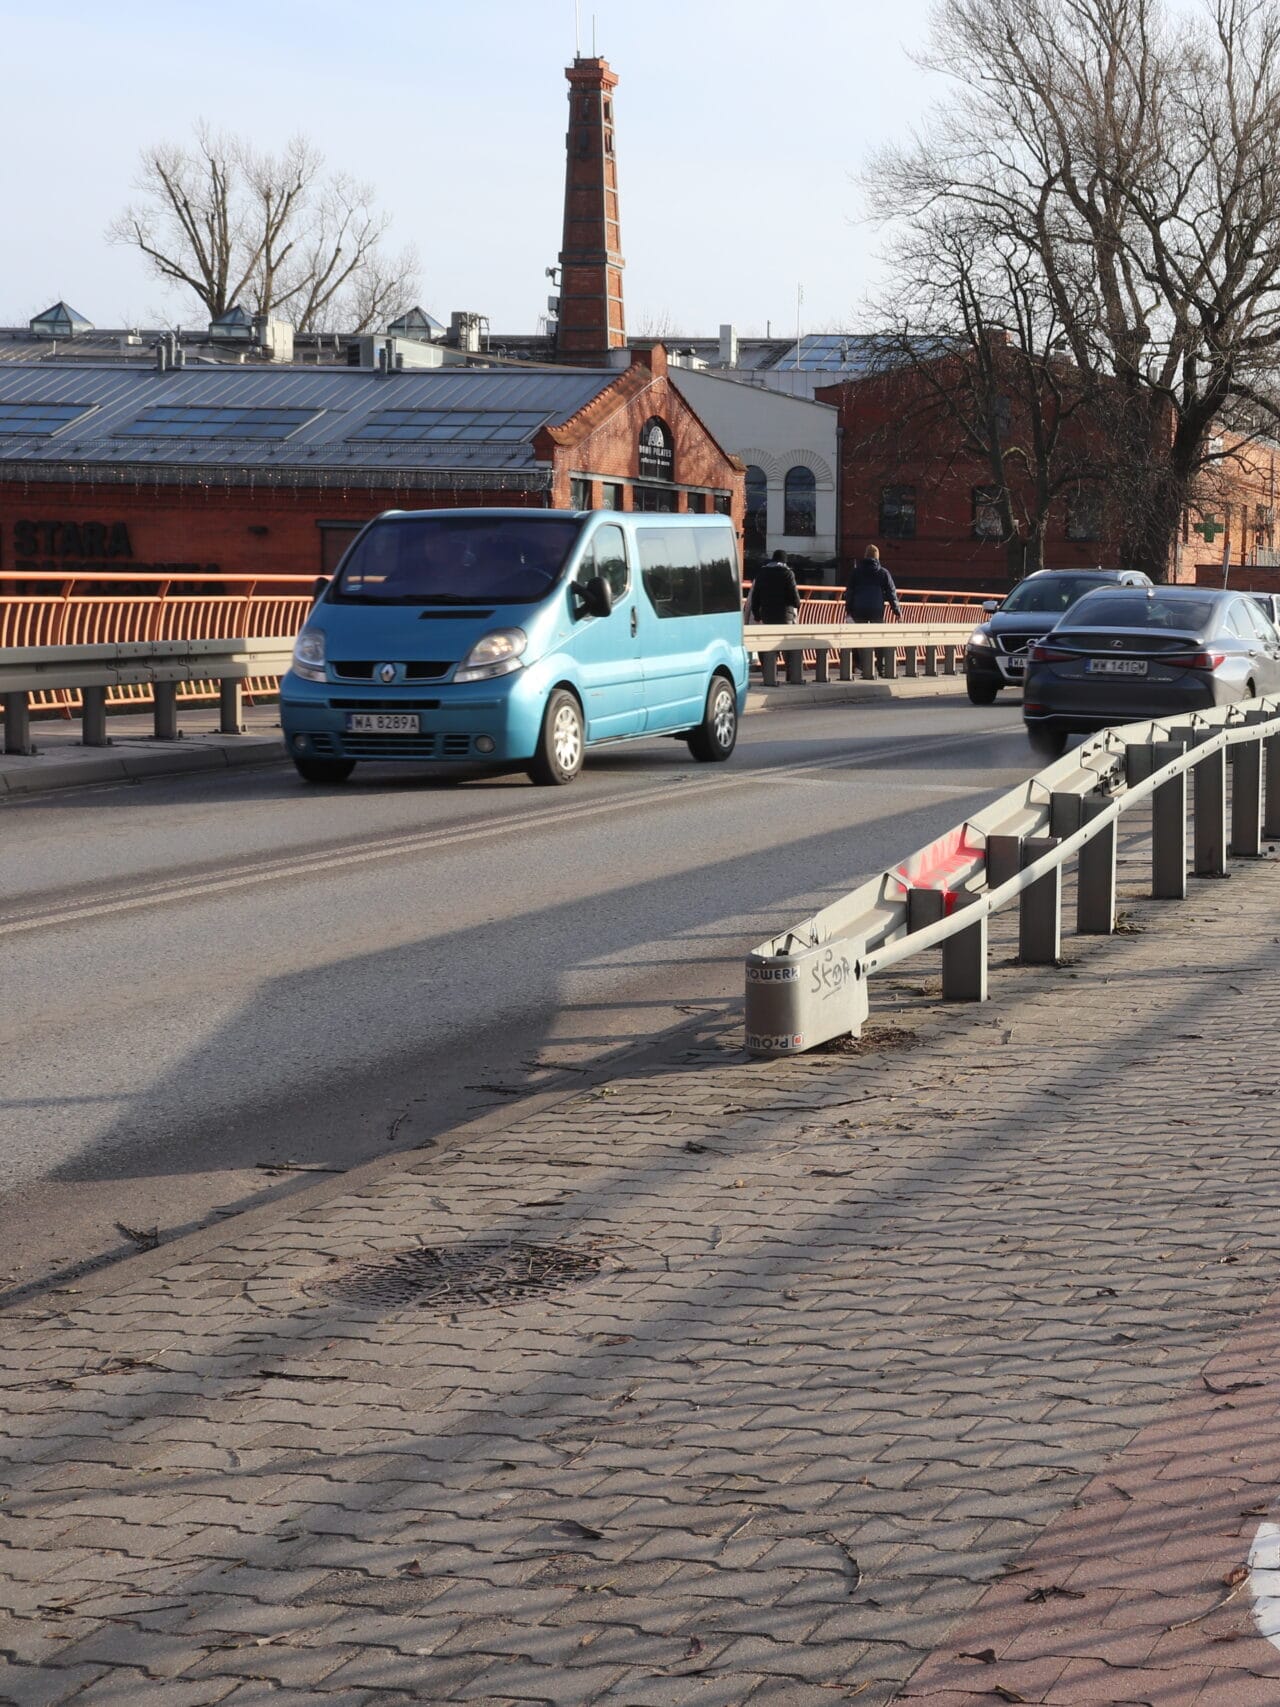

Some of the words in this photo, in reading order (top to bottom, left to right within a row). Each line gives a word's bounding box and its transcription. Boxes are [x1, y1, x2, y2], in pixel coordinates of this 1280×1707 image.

[13, 519, 134, 558] STARA
[355, 716, 373, 729] WA
[376, 715, 418, 729] 8289A
